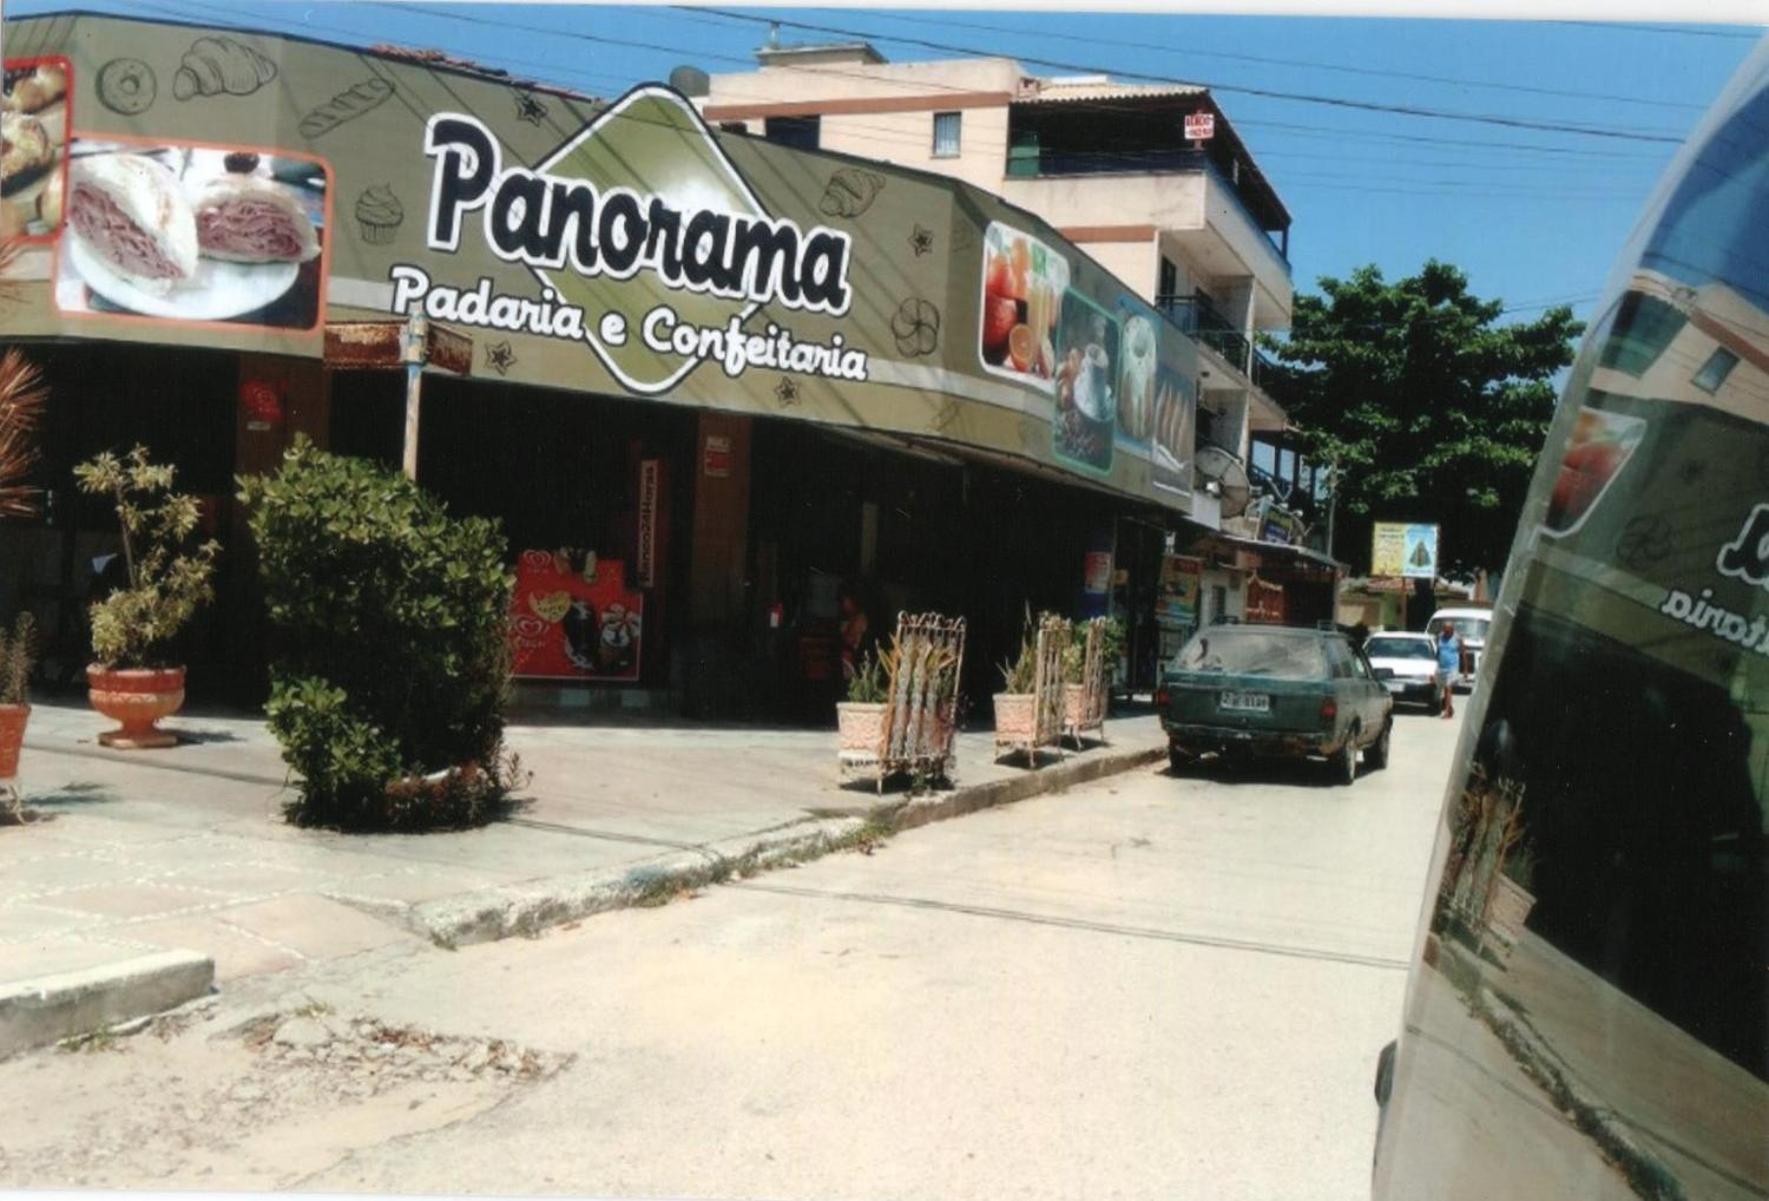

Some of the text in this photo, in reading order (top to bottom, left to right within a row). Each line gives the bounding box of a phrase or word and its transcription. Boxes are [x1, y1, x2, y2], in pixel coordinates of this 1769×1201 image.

[424, 112, 852, 315] Panorama
[391, 268, 868, 376] Padaria e Confeitaria
